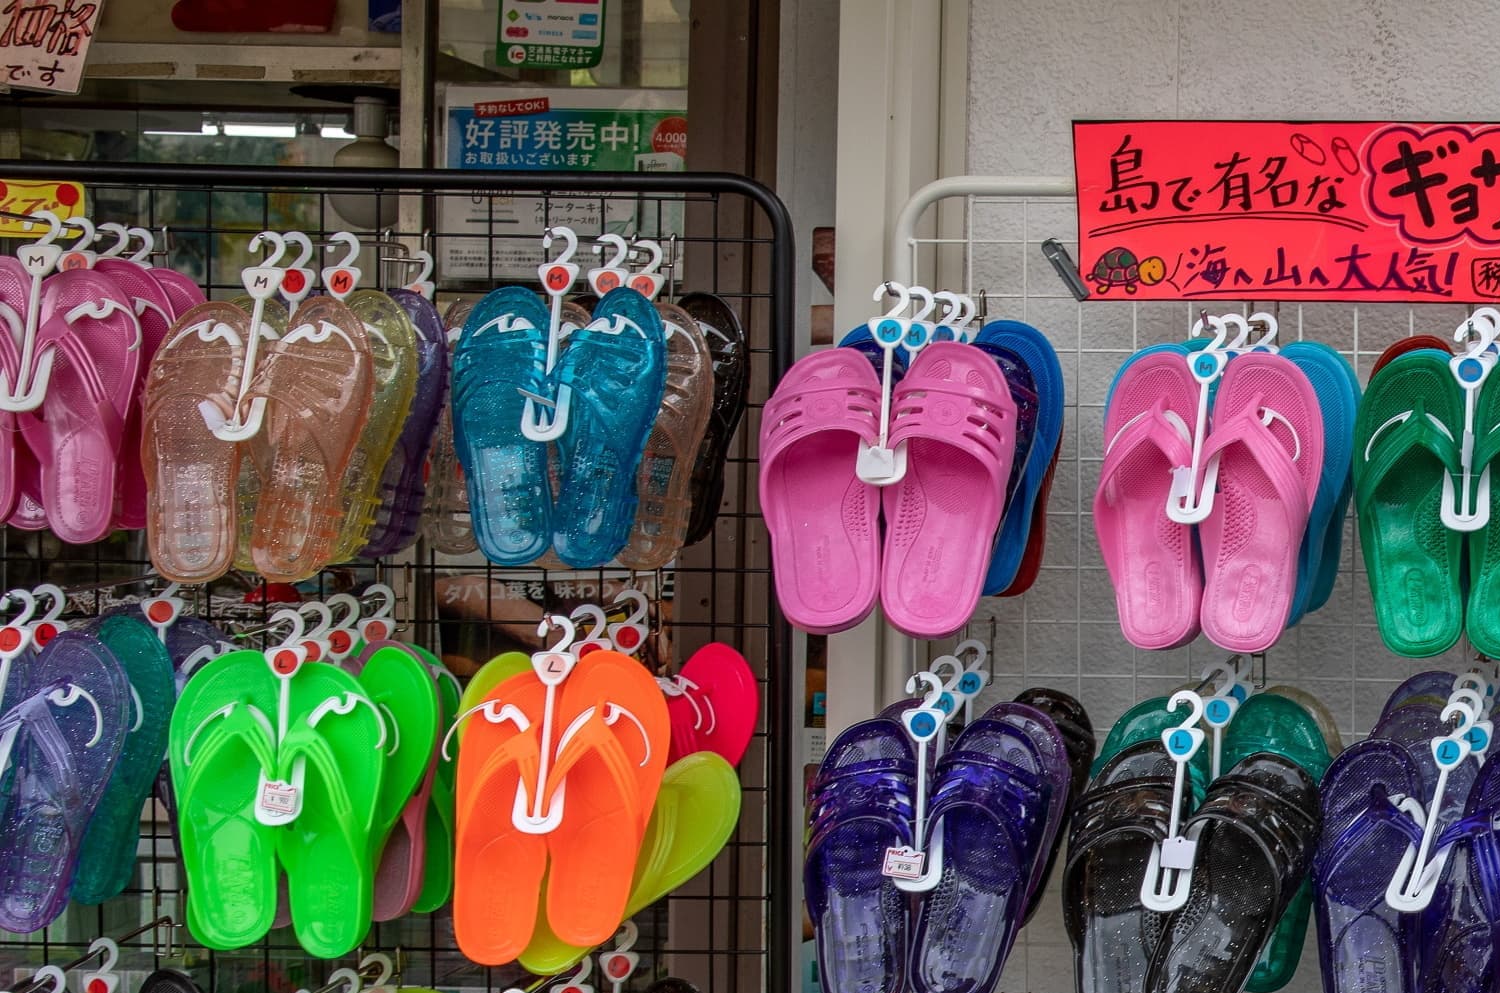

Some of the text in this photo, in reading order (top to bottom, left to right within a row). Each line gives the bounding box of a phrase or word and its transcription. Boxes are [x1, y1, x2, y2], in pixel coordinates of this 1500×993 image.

[6, 60, 64, 86] です
[465, 118, 640, 151] 好評発売中!
[1099, 134, 1347, 214] 島で有名な
[535, 202, 614, 214] スターターキト
